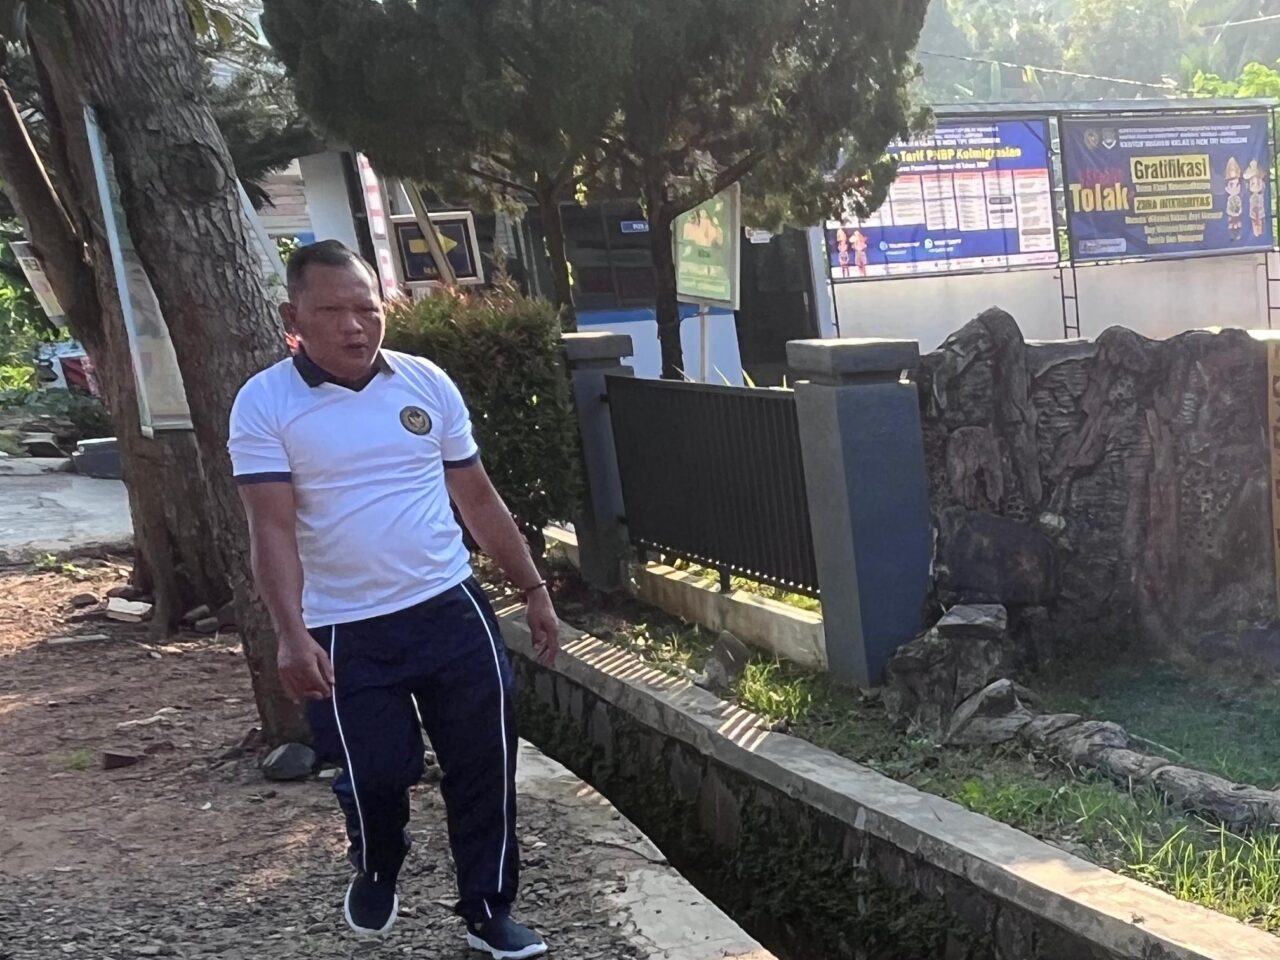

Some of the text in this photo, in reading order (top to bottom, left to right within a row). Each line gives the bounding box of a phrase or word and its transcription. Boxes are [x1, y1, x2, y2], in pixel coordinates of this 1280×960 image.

[900, 150, 925, 162] Tarif
[1134, 157, 1208, 180] Gratifikasi
[1069, 182, 1130, 212] Tolak
